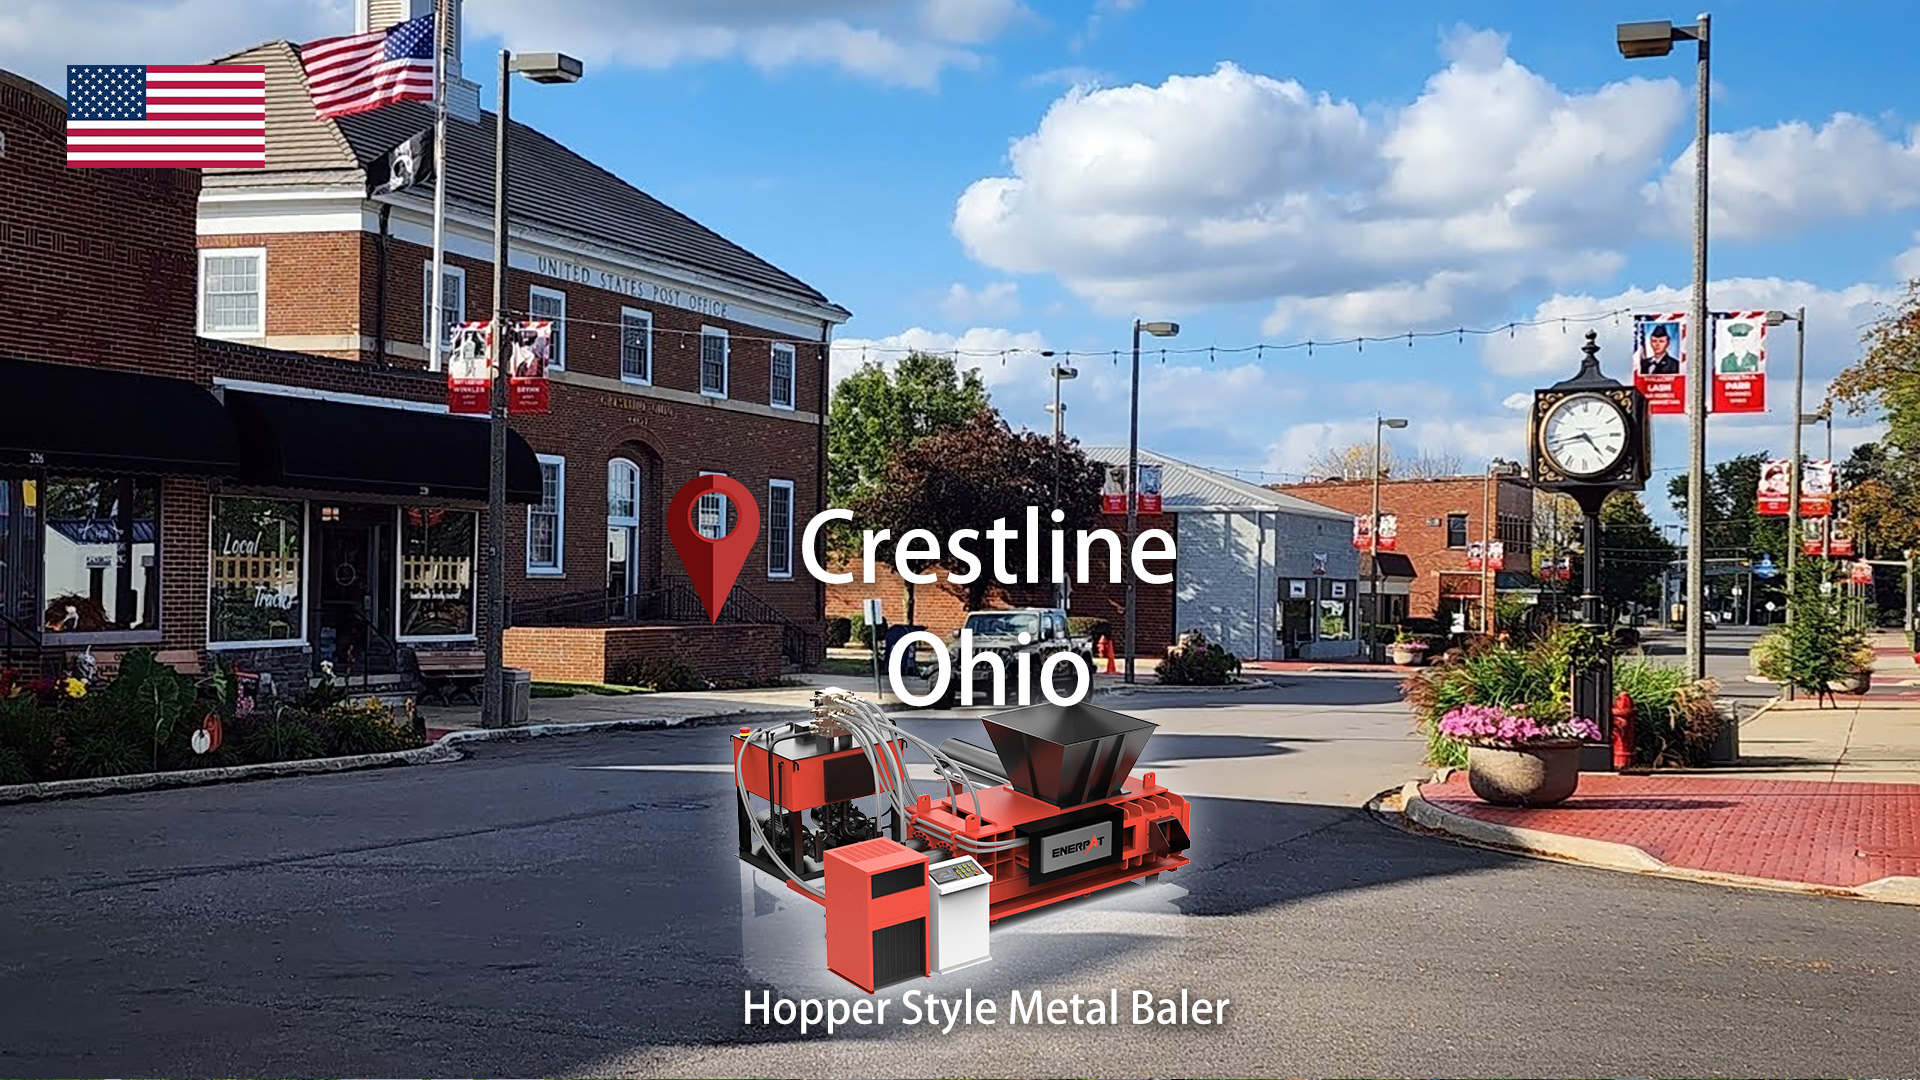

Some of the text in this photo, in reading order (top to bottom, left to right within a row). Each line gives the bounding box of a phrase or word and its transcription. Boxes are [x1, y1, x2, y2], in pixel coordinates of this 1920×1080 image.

[537, 256, 727, 317] UNITED STATES POST OFFICE
[29, 452, 44, 463] 226
[223, 531, 262, 555] Local
[1052, 834, 1104, 858] ENERPAT
